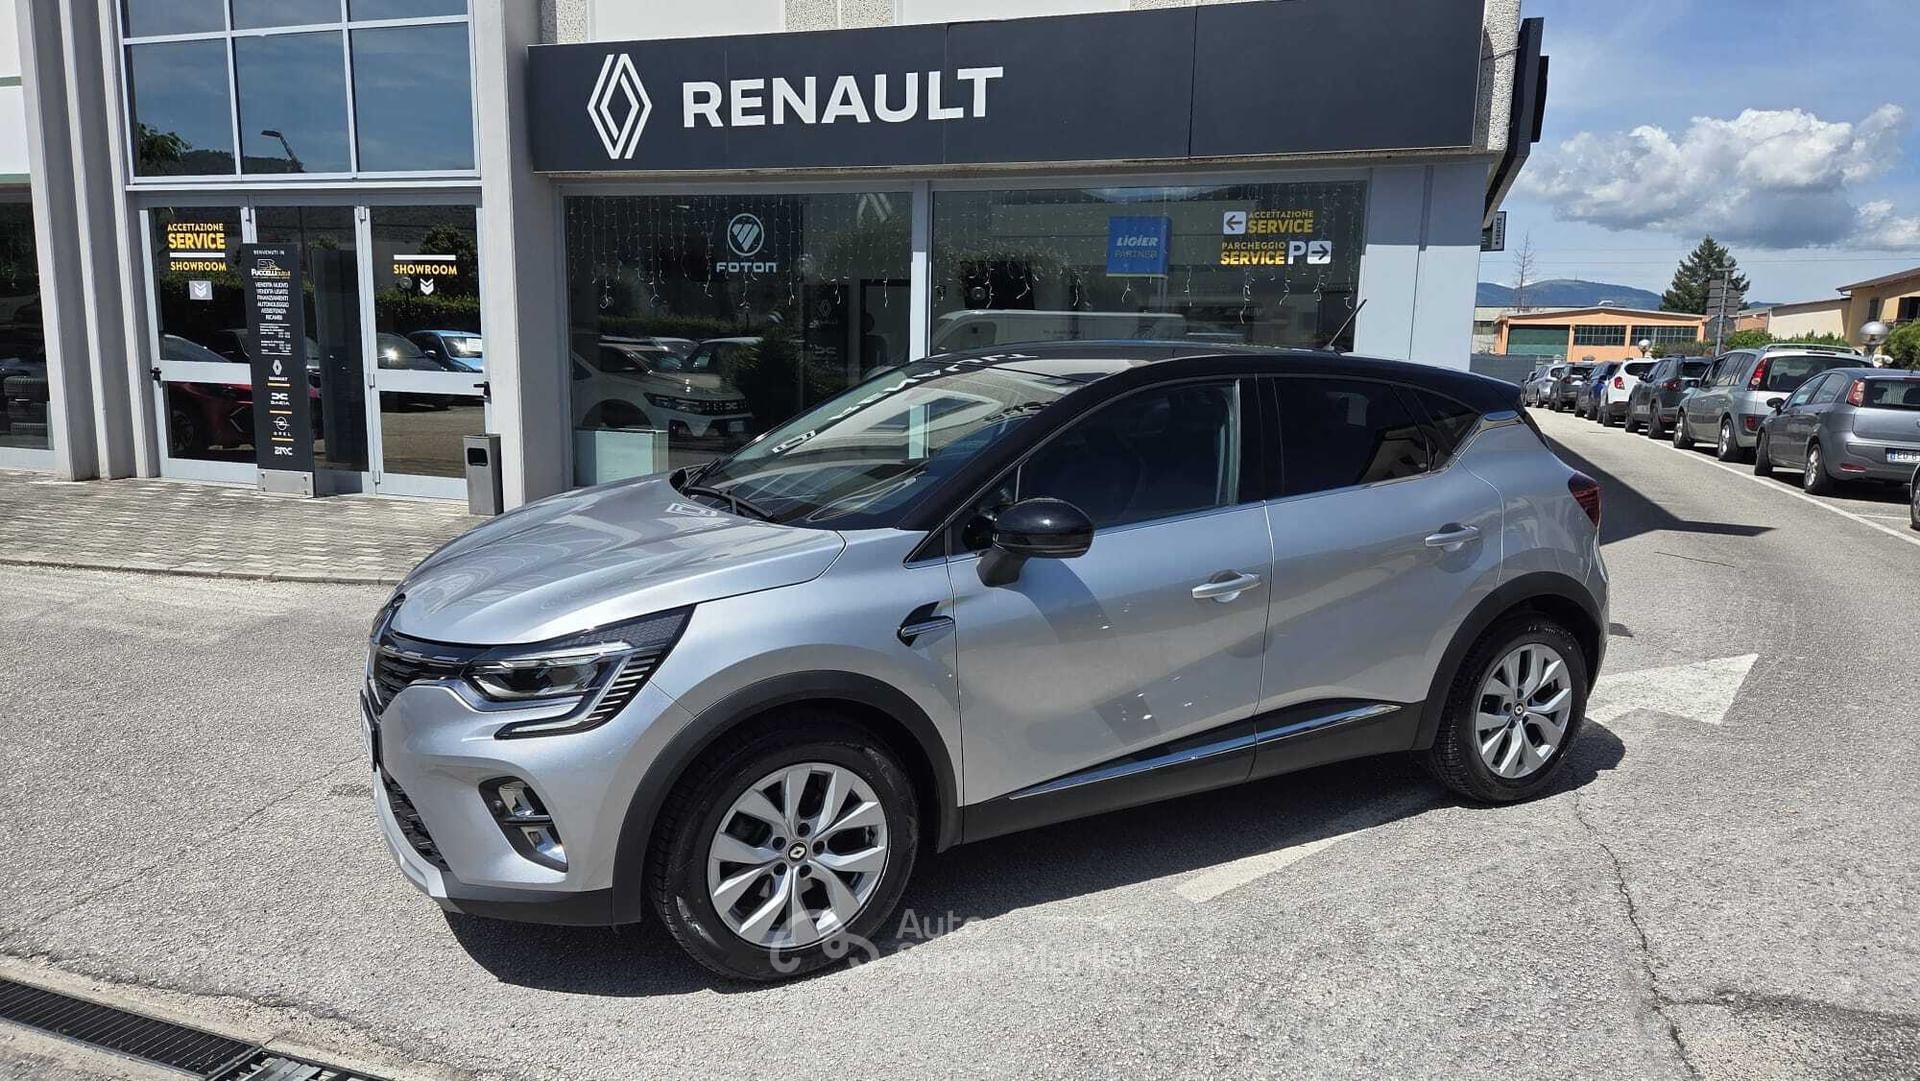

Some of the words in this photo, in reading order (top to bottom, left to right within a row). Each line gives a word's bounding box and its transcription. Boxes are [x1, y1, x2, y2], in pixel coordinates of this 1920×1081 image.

[682, 66, 1004, 128] RENAULT
[1248, 209, 1314, 219] ACCETTAZIONE
[167, 223, 225, 231] ACCETTAZIONE
[1247, 219, 1314, 234] SERVICE
[168, 232, 226, 249] SERVICE
[1221, 241, 1286, 251] PARCHEGGIO
[1220, 250, 1285, 265] SERVICE
[170, 261, 227, 272] SHOWROOM
[393, 263, 458, 276] SHOWROOM
[716, 262, 777, 273] FOTON
